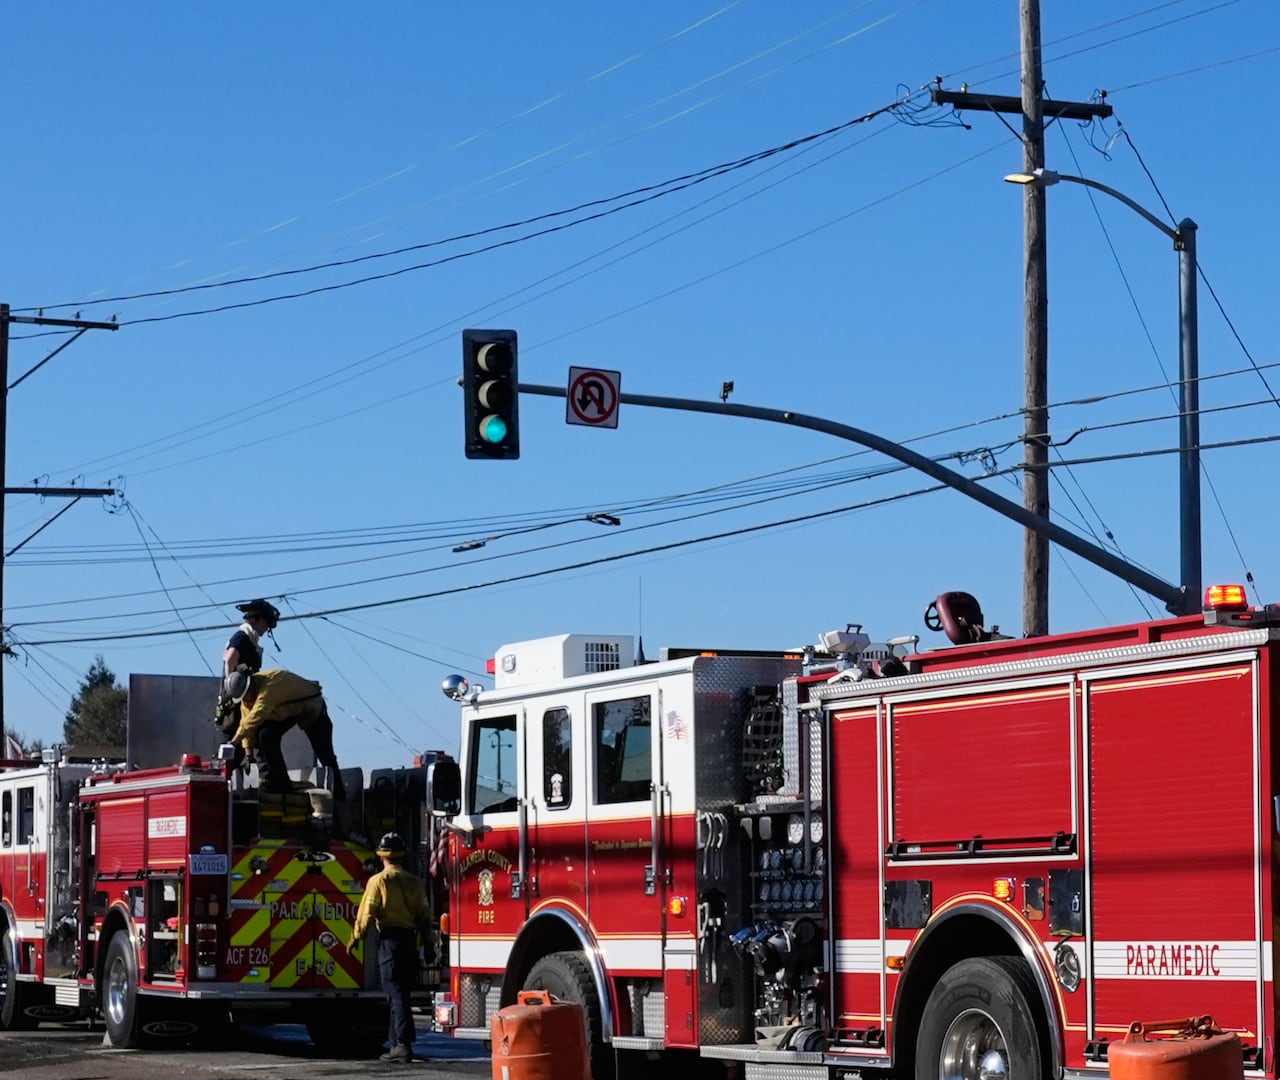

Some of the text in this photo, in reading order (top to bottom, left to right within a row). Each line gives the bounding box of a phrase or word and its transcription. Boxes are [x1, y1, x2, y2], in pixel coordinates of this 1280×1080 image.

[271, 902, 358, 920] PARAMEDIC
[478, 910, 495, 924] FIRE
[226, 948, 269, 965] ACF E26
[1126, 944, 1220, 976] PARAMEDIC
